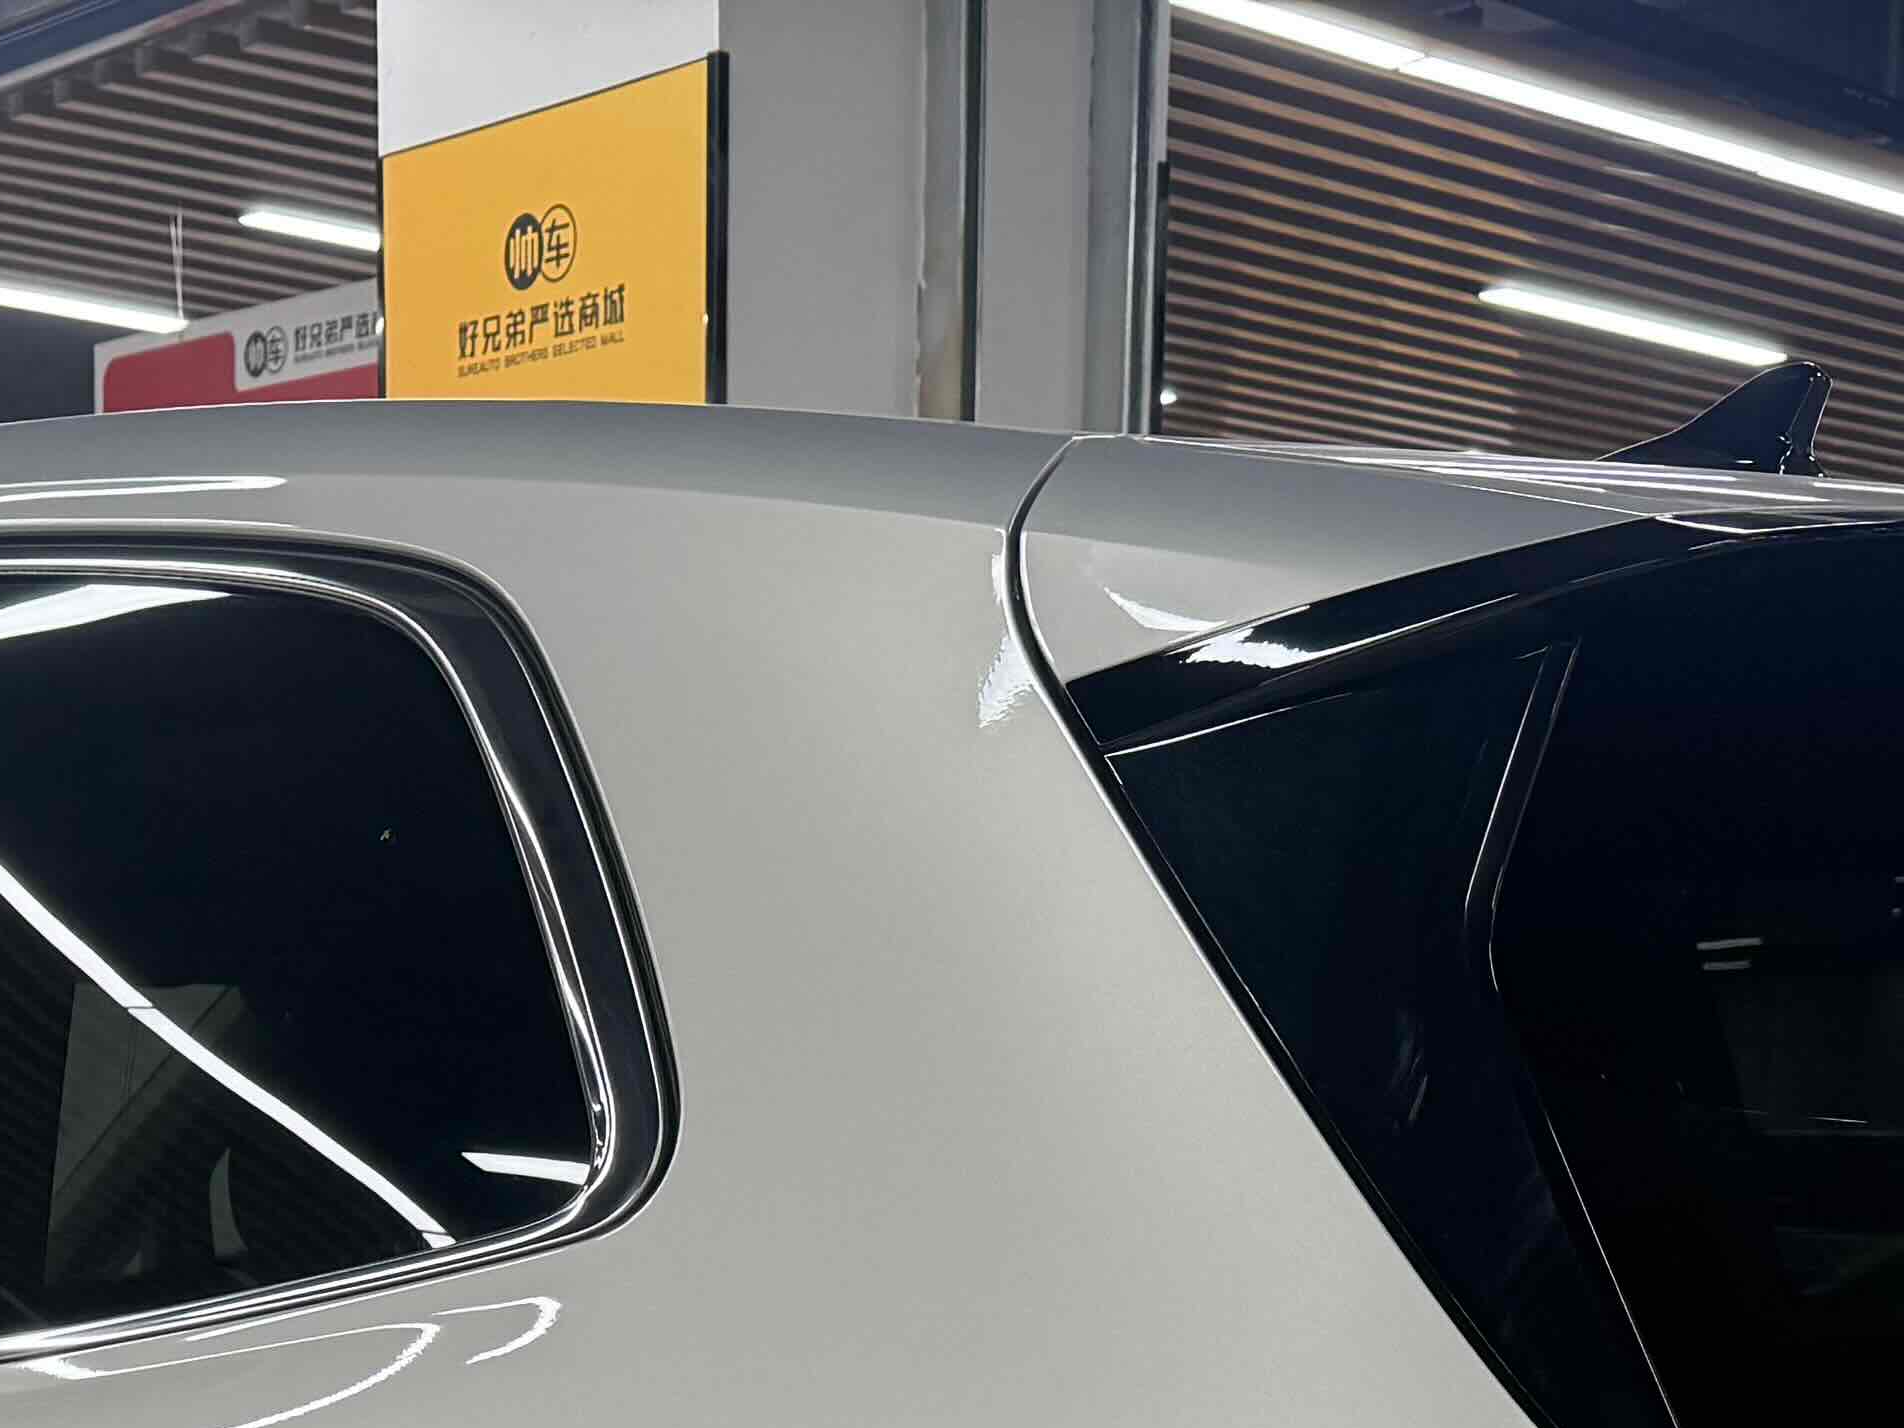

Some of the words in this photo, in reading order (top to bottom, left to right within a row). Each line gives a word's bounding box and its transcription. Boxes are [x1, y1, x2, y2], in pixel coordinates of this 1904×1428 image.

[458, 283, 625, 360] 好兄弟严选商城
